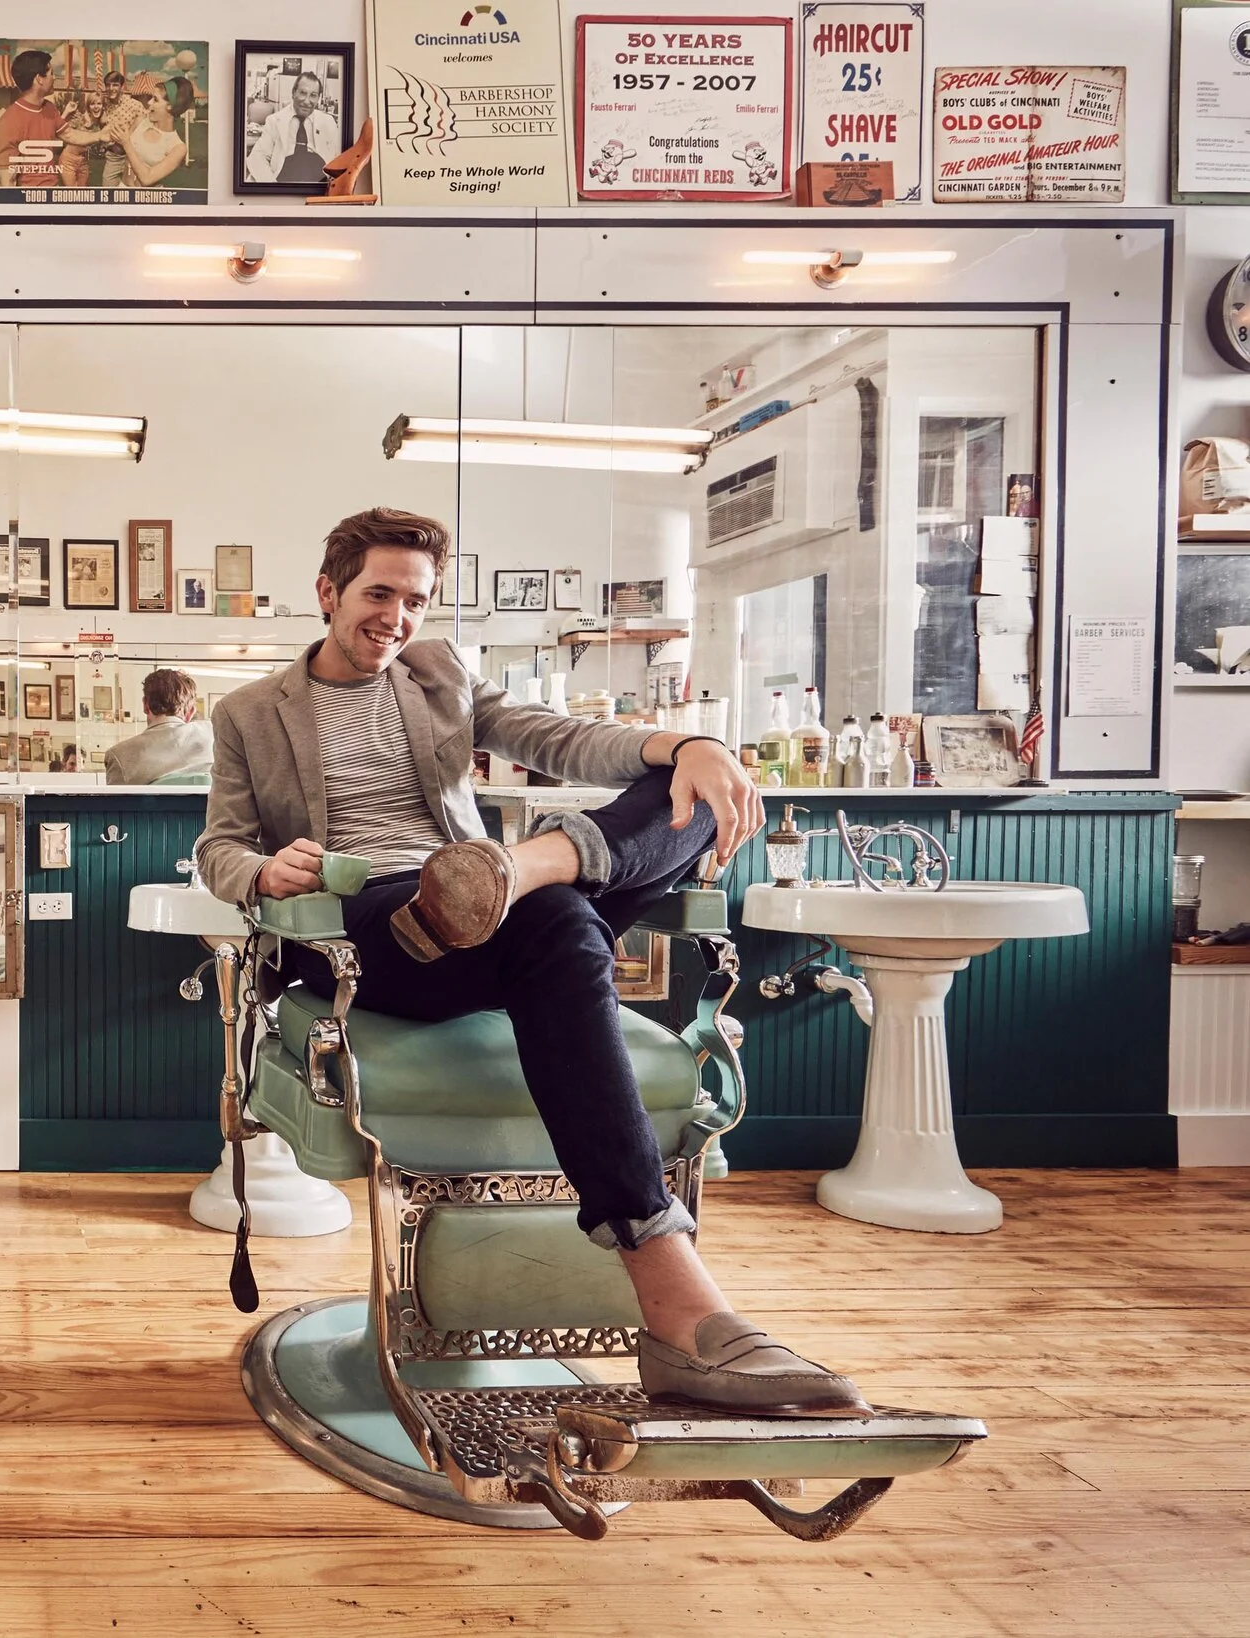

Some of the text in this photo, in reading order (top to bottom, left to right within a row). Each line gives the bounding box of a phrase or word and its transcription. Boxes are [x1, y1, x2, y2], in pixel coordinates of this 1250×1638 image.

[414, 31, 520, 46] Cincinnati USA
[627, 33, 743, 49] 50 YEARS
[813, 23, 914, 57] HAIRCUT
[443, 52, 493, 63] welcomes
[613, 73, 671, 90] 1957
[692, 75, 757, 91] 2007
[842, 62, 881, 92] 25¢
[939, 68, 1069, 92] SPECIAL SHOW!
[460, 88, 554, 102] BARBERSHOP
[590, 102, 613, 112] Fausto
[614, 102, 637, 112] Ferrari
[735, 103, 779, 114] Emilio Ferrari
[942, 98, 968, 108] BOYS'
[970, 98, 996, 108] CLUBS
[999, 98, 1008, 108] of
[1079, 98, 1111, 112] WELFARE
[475, 104, 555, 118] HARMONY
[1073, 106, 1113, 122] ACTIVITIES
[491, 120, 556, 135] SOCIETY
[942, 114, 1043, 131] OLD GOLD
[824, 113, 897, 148] SHAVE
[649, 135, 719, 150] Congratulations
[948, 136, 981, 145] Presents
[665, 152, 703, 164] from the
[940, 133, 1120, 178] THE ORIGINAL AMATEUR HOUR
[8, 164, 64, 174] STEPHAN
[404, 165, 545, 180] Keep The Whole World
[1027, 162, 1043, 171] BIG
[1045, 162, 1122, 172] ENTERTAINMENT
[632, 168, 735, 185] CINCINNATI REDS
[449, 180, 501, 194] Singing!
[938, 183, 985, 193] CINCINNATI
[988, 183, 1021, 192] GARDEN
[1052, 183, 1086, 192] December
[1100, 183, 1106, 192] 9
[52, 190, 95, 203] GROOMING
[100, 191, 109, 203] IS
[114, 191, 130, 203] OUR
[1238, 326, 1248, 342] 8
[1074, 628, 1146, 638] BARBER SERVICES
